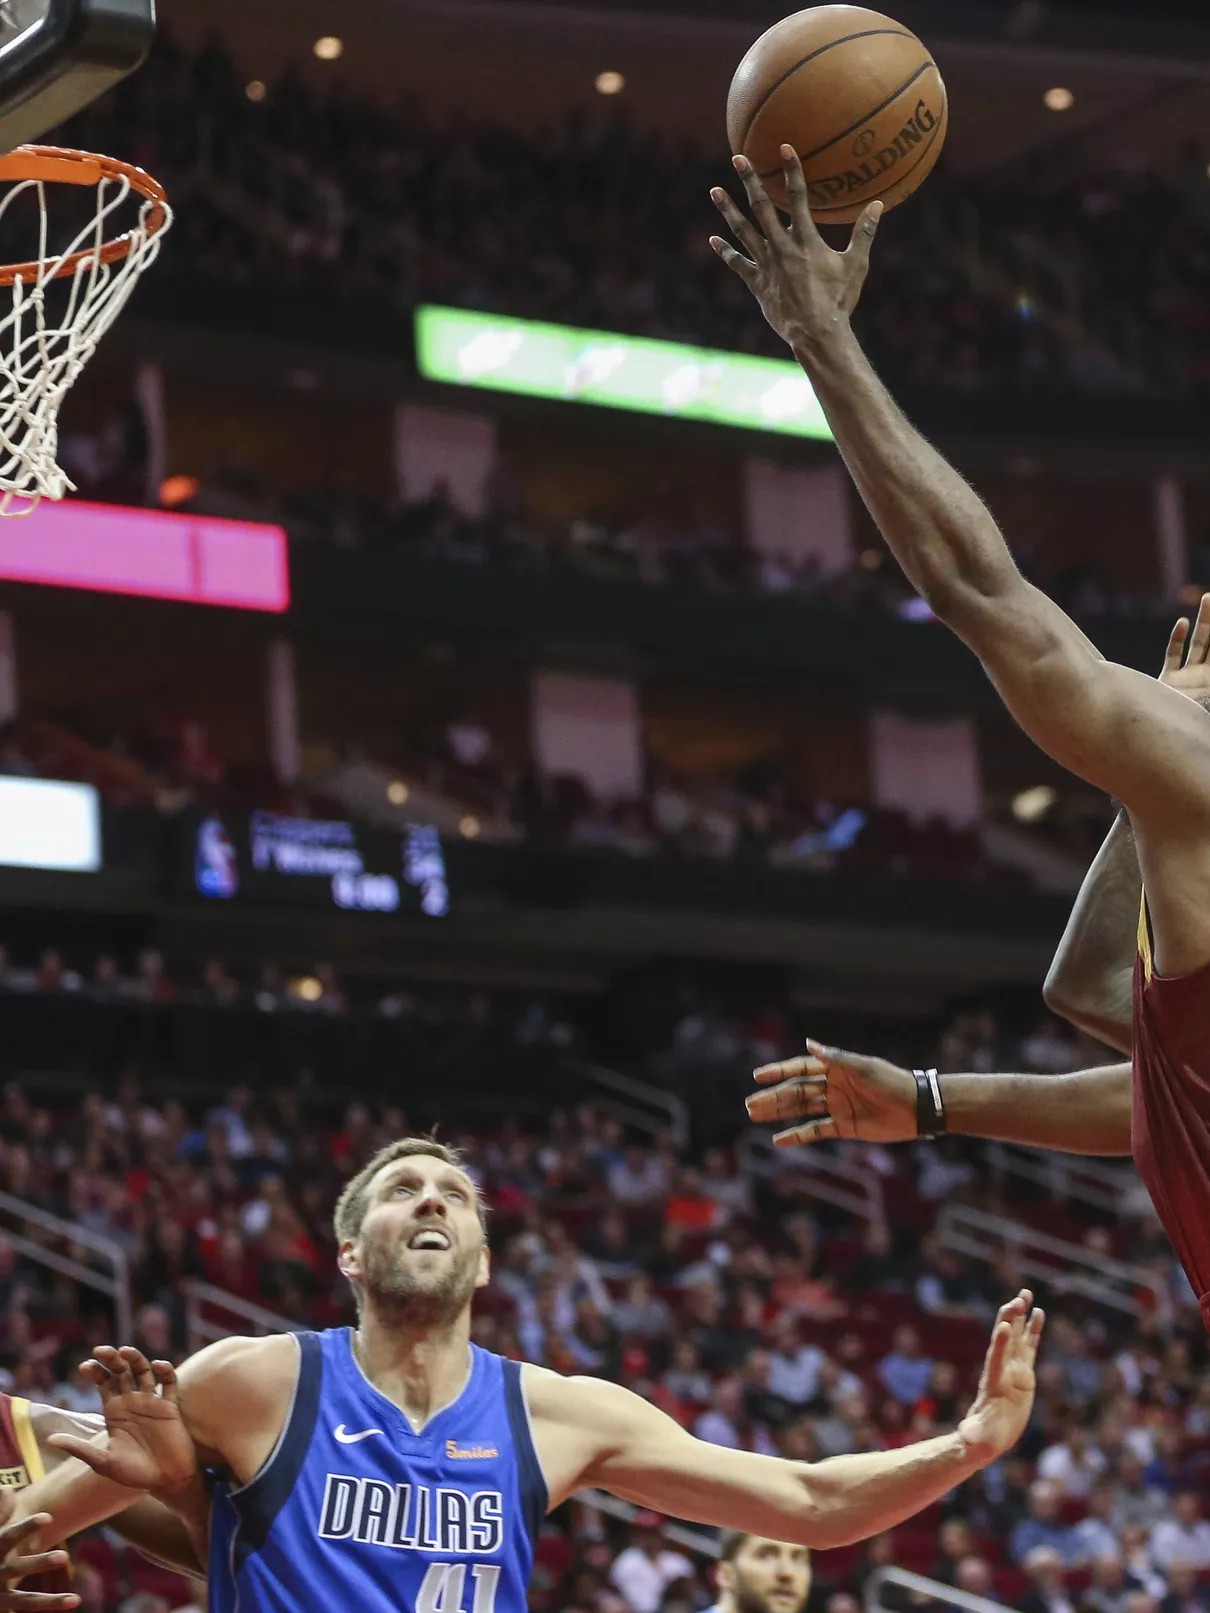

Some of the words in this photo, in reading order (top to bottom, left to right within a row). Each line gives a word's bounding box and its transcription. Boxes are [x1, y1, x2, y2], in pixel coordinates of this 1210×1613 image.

[806, 99, 936, 206] SPALDING
[318, 1473, 504, 1555] DALLAS
[414, 1562, 502, 1613] 41
